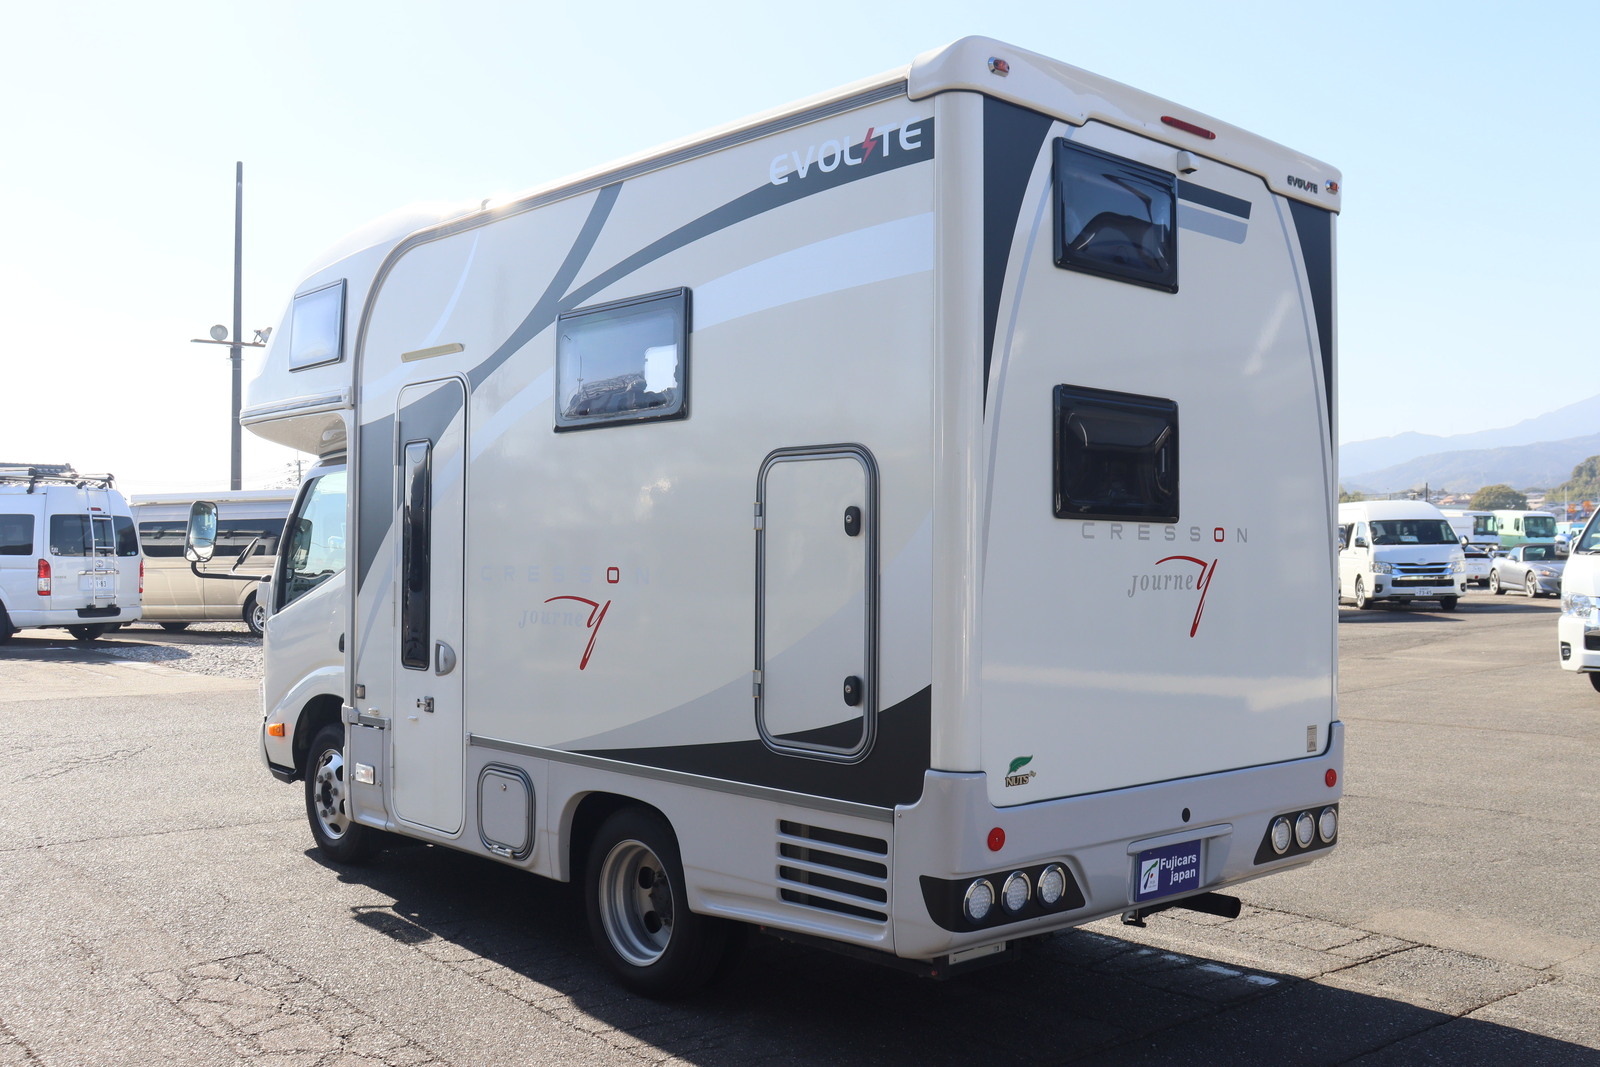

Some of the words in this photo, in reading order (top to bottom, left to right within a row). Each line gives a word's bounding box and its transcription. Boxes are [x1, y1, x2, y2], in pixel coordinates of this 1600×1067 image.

[1081, 522, 1249, 544] CRESSON
[480, 564, 651, 585] CRESSON
[1004, 773, 1030, 788] NUTS
[1160, 854, 1197, 871] Fujicars
[1169, 868, 1196, 886] japan
